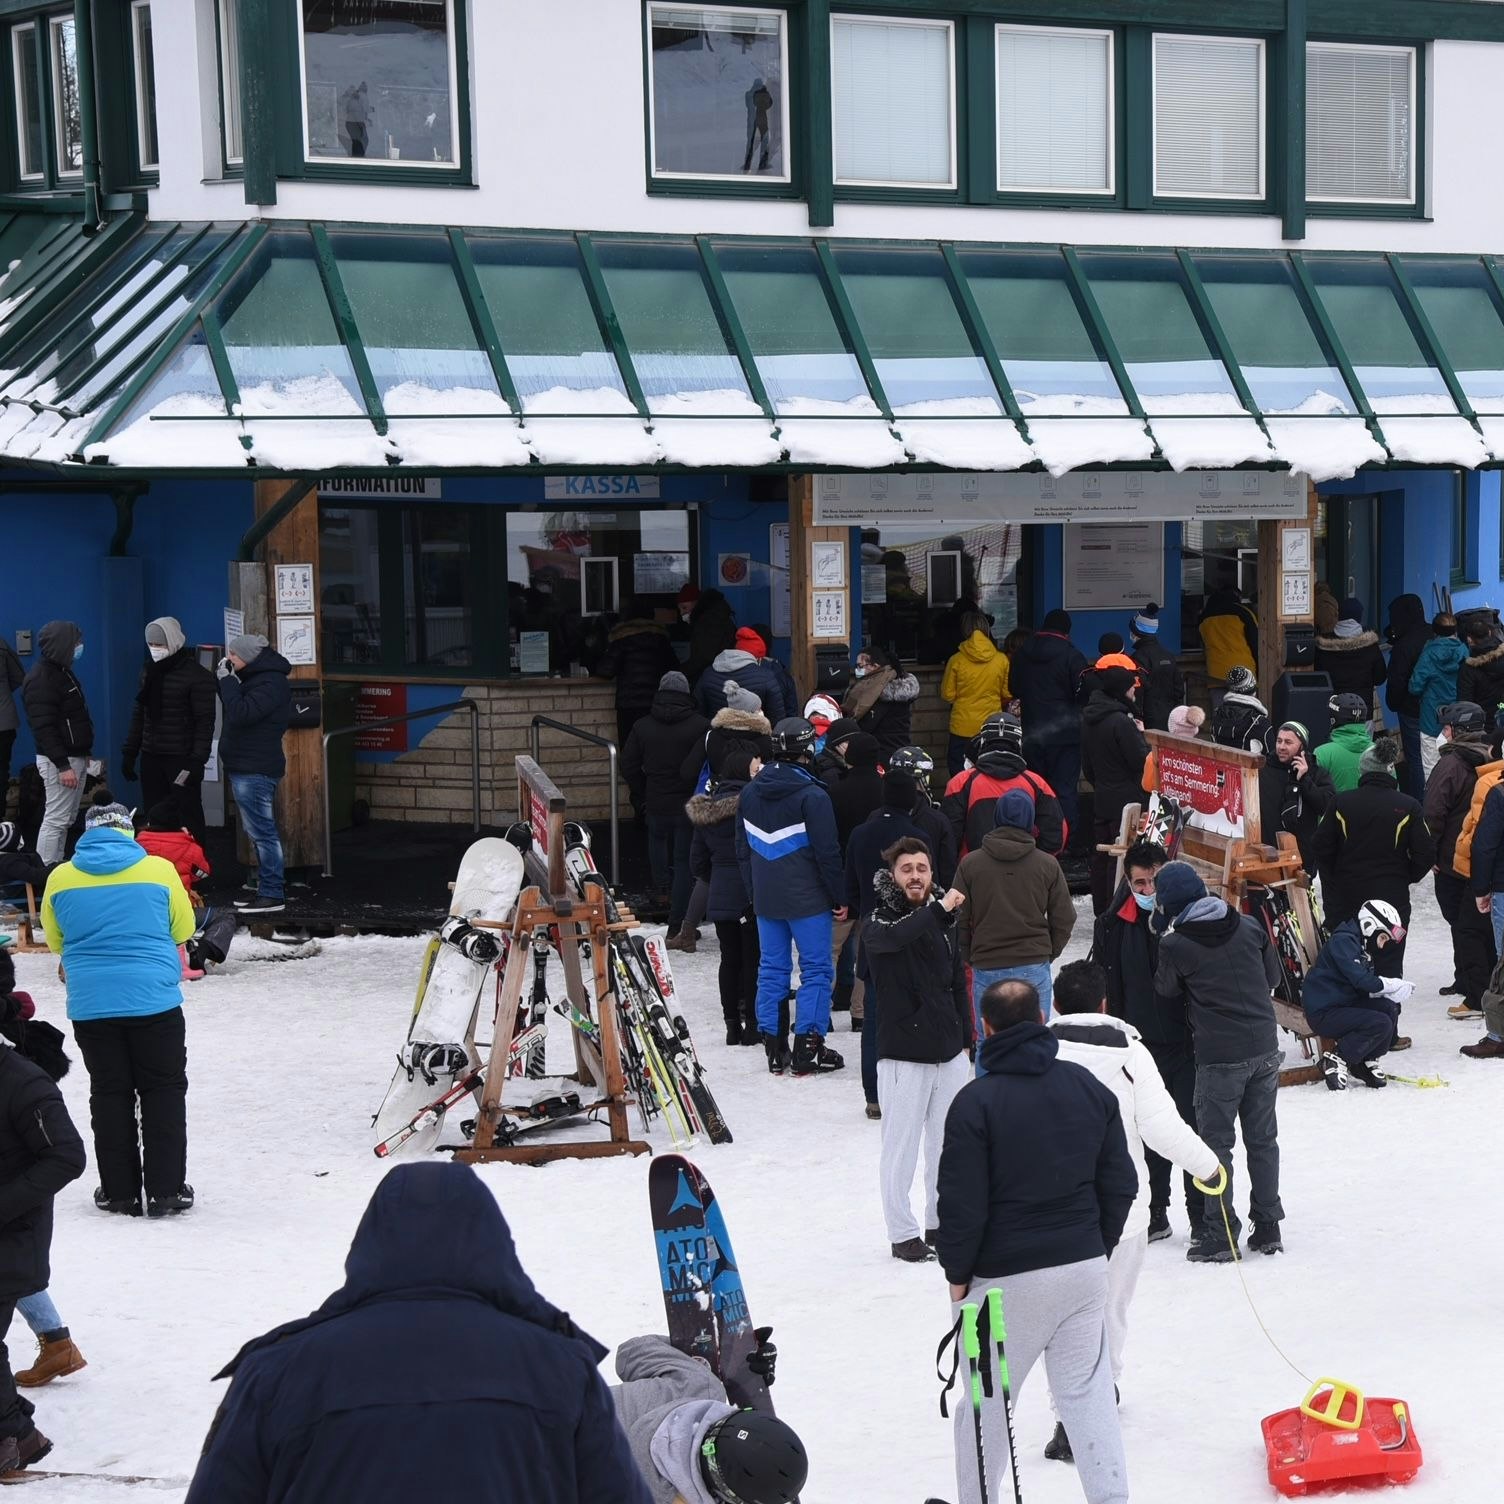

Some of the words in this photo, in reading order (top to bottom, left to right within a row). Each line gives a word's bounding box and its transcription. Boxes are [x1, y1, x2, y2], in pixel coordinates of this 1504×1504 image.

[565, 476, 641, 495] KASSA
[1162, 754, 1173, 767] Am
[1173, 757, 1203, 775] schönsten
[1174, 774, 1184, 785] am
[1184, 774, 1220, 798] Semmering:
